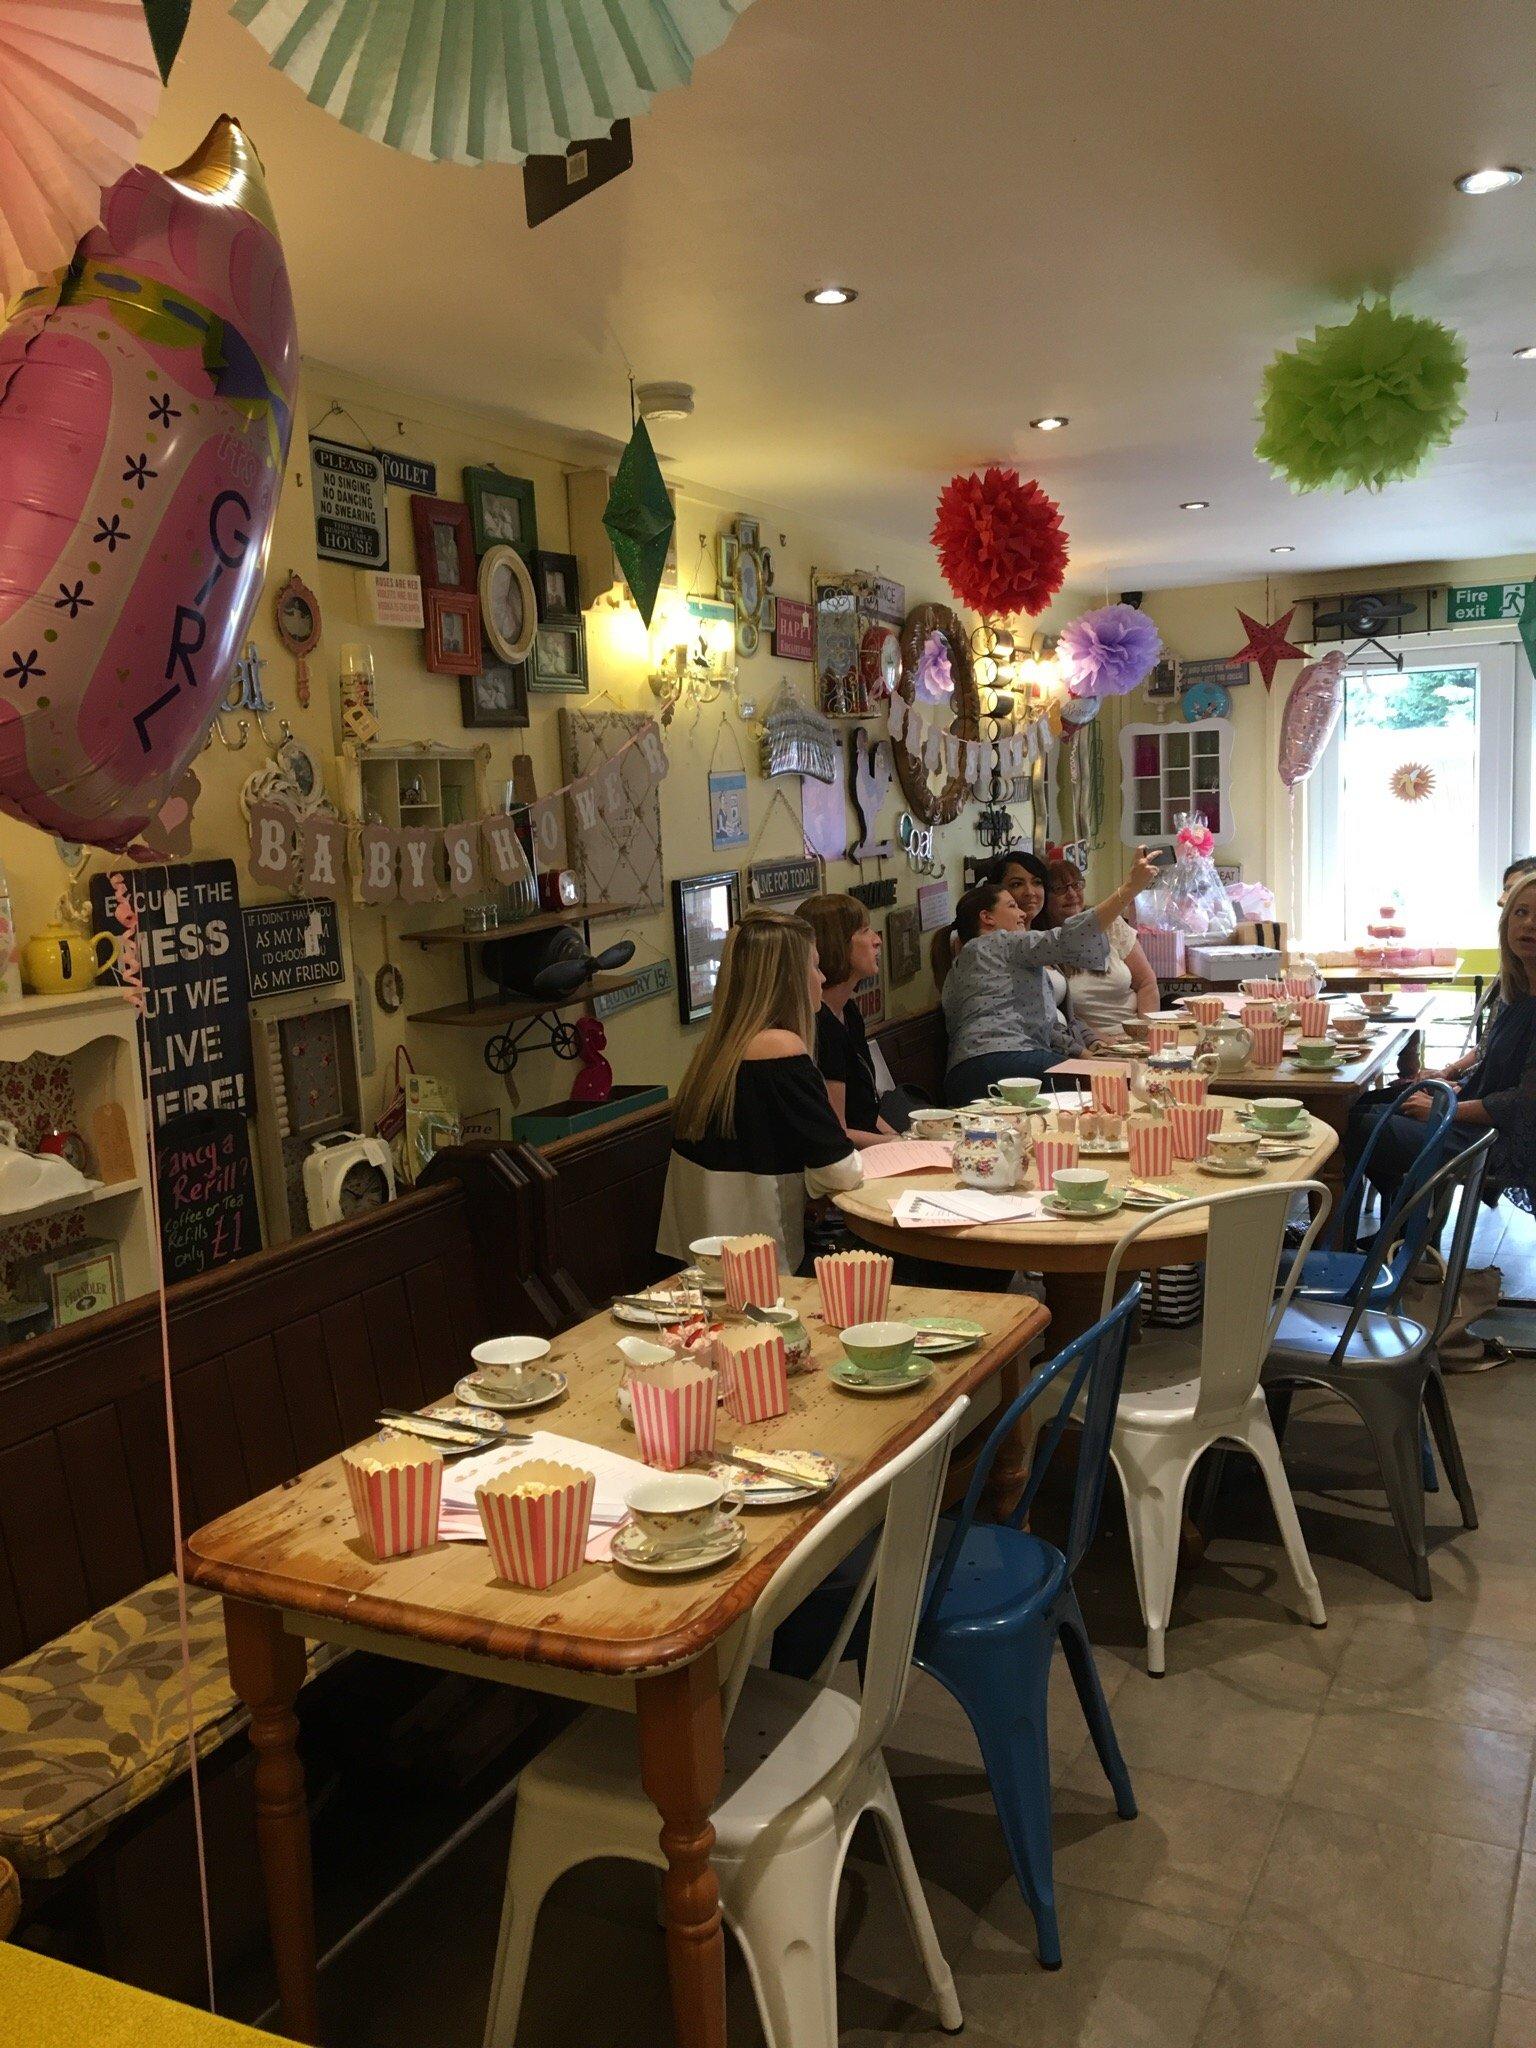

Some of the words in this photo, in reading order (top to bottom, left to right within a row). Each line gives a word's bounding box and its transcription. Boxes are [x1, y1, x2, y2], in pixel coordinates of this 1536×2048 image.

[320, 452, 373, 477] PLEASE
[382, 454, 428, 485] TOILET
[324, 473, 335, 486] NO
[338, 476, 371, 494] SINGING
[322, 487, 335, 499] NO
[337, 490, 373, 509] DANCING
[320, 500, 332, 514] NO
[335, 504, 375, 524] SWEARING
[325, 532, 373, 556] HOUSE
[1456, 590, 1488, 603] Fire
[133, 490, 250, 752] GIRL
[1455, 605, 1486, 619] exit
[258, 818, 427, 889] BABY
[774, 870, 790, 893] FOR
[789, 866, 815, 888] TODAY
[105, 886, 189, 917] ECUE
[194, 881, 233, 904] THE
[248, 915, 256, 926] IF
[262, 911, 290, 925] DIDN'T
[256, 930, 269, 948] AS
[273, 927, 293, 946] MY
[263, 952, 274, 965] I'D
[275, 948, 305, 963] CHOOS
[253, 972, 268, 990] AS
[271, 968, 292, 987] MY
[295, 960, 339, 982] FRIEND
[142, 986, 177, 1019] UT
[185, 976, 229, 1010] WE
[601, 974, 650, 1011] AUNDRY
[144, 1025, 223, 1076] LIVE
[145, 1073, 246, 1128] ERE!
[158, 1142, 218, 1180] Fancy
[223, 1133, 234, 1154] a
[206, 1203, 220, 1217] or
[222, 1194, 244, 1209] Tea
[211, 1210, 242, 1260] £1
[175, 1244, 205, 1272] only
